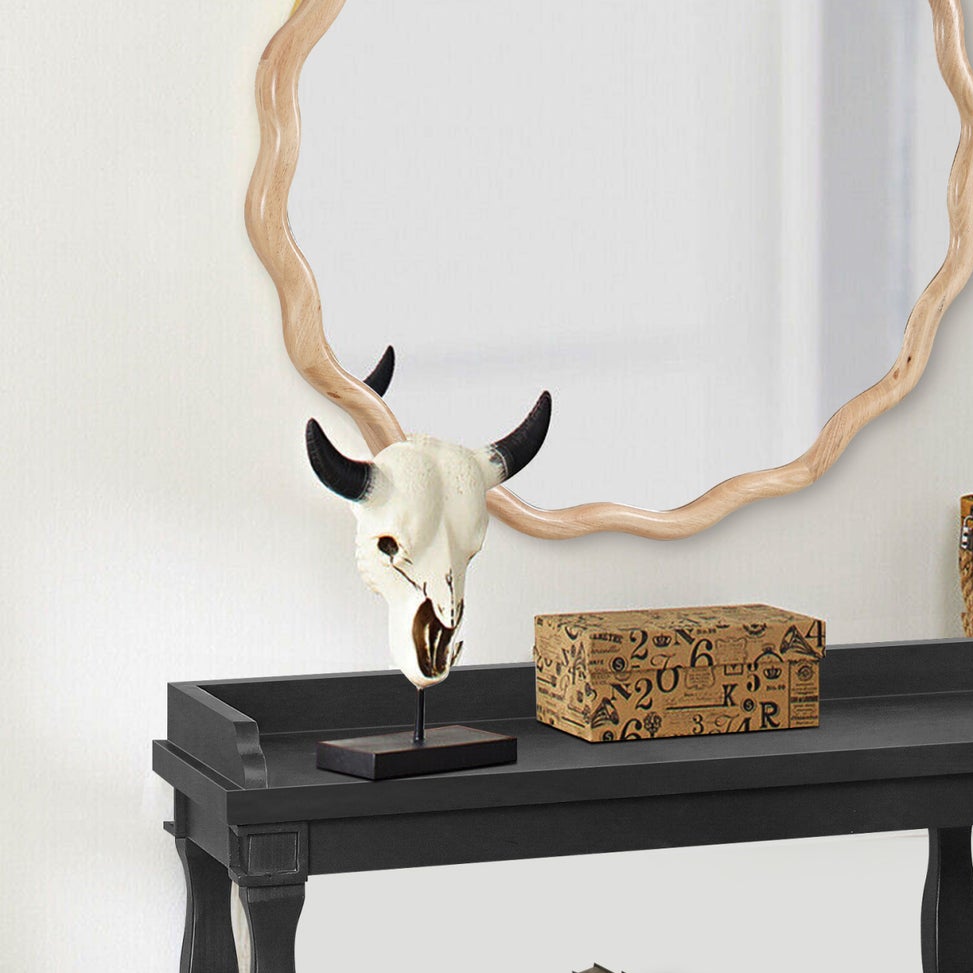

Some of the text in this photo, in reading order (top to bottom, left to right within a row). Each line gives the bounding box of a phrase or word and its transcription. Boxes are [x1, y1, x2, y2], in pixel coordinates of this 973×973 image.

[629, 629, 649, 661] 2
[635, 677, 653, 710] 2
[722, 683, 738, 707] K
[760, 701, 781, 728] R
